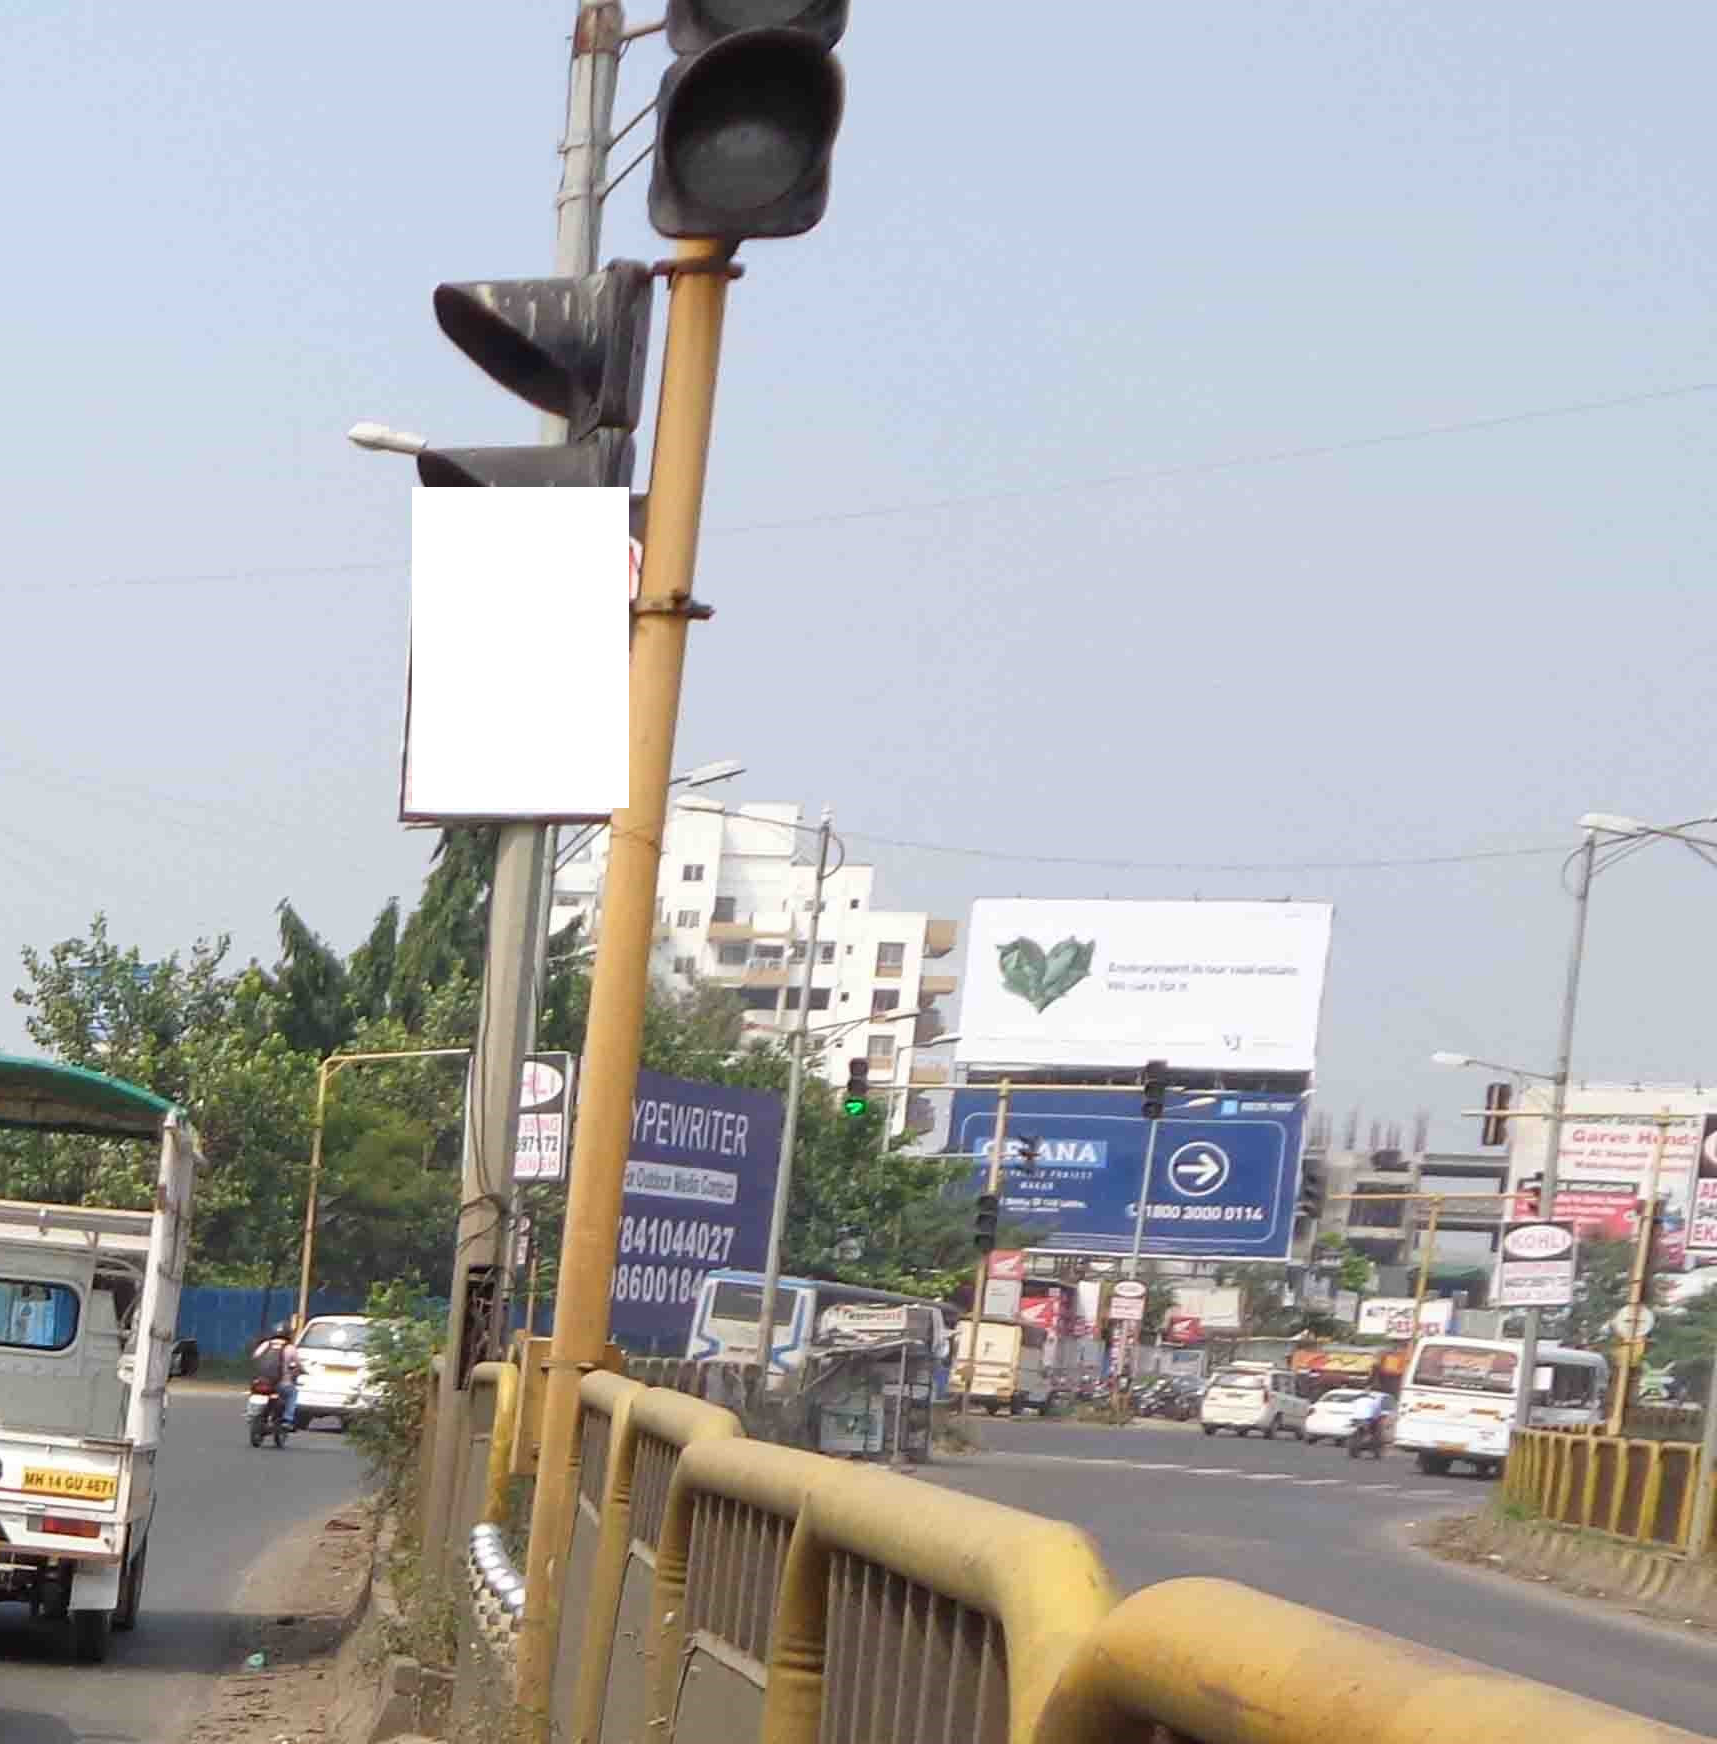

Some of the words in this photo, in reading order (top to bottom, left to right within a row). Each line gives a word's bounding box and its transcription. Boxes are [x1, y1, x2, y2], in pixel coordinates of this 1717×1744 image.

[619, 1215, 734, 1264] 841044027
[24, 1471, 46, 1487] MH
[48, 1473, 62, 1488] 14
[65, 1474, 84, 1491] GU
